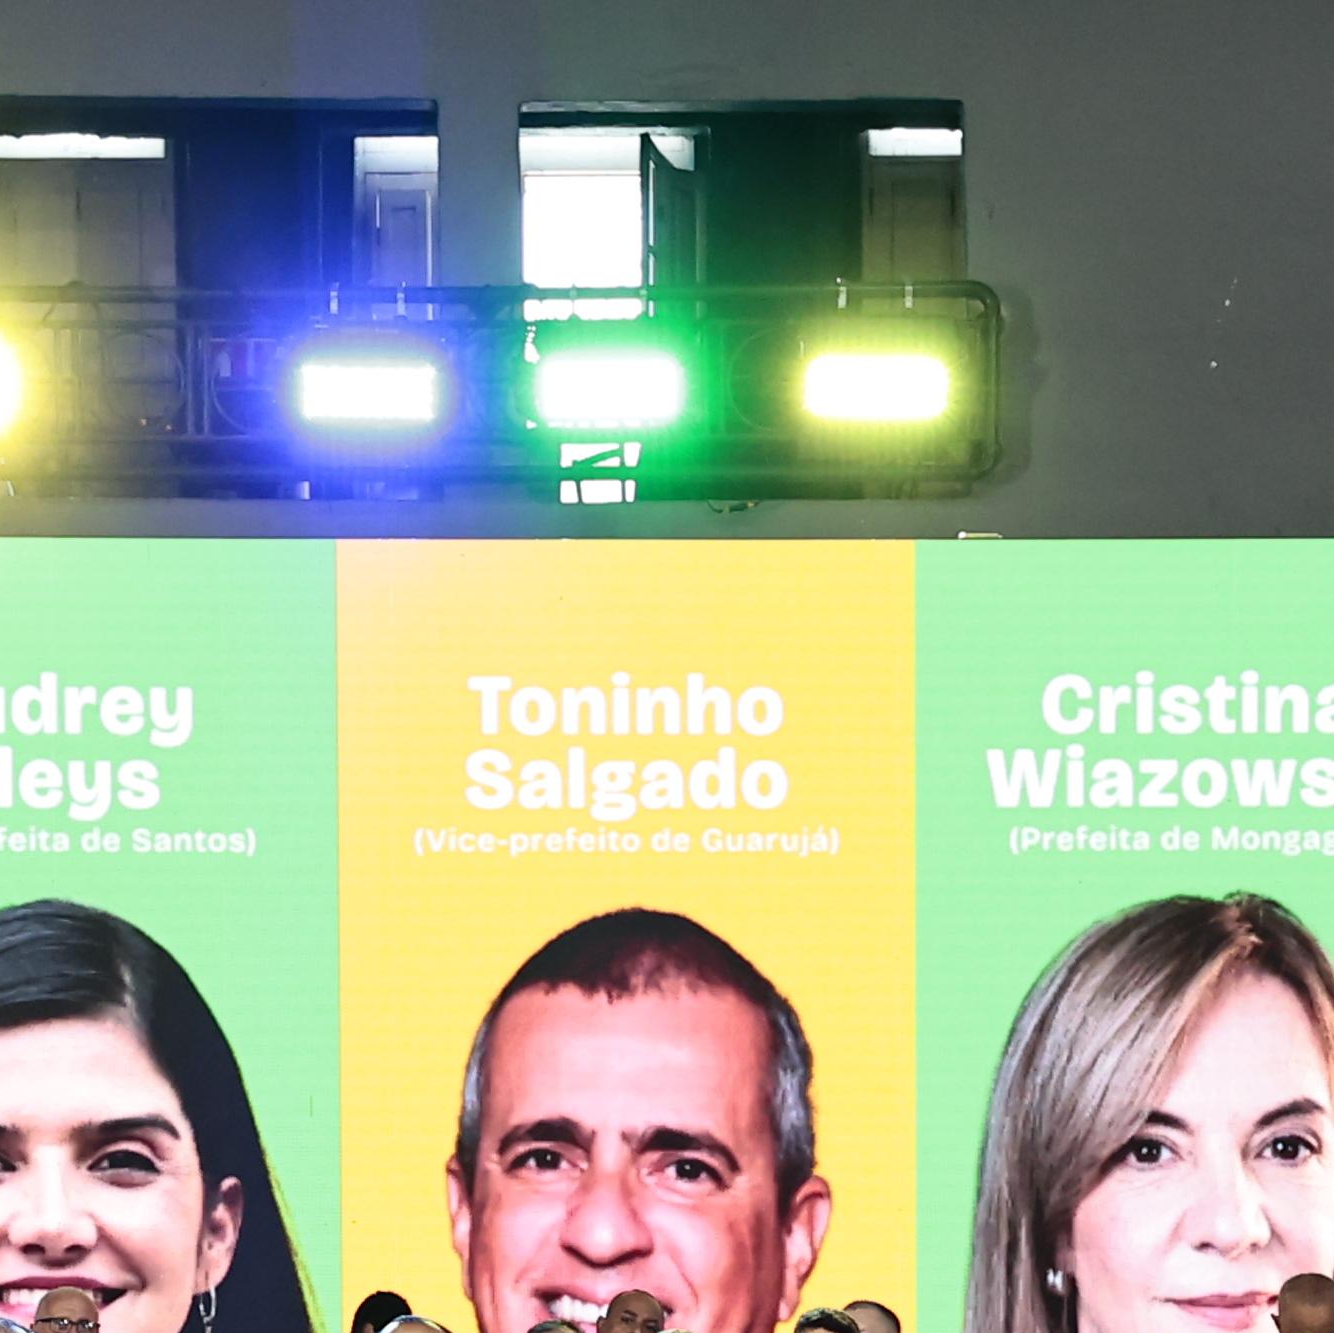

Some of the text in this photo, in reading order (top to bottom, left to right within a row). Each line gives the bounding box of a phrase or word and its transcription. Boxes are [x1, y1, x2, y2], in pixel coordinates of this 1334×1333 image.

[467, 671, 784, 737] Toninho
[465, 746, 789, 821] Salgado
[80, 827, 121, 853] de
[131, 828, 257, 857] Santos)
[413, 826, 841, 858] (Vice-prefeito de Guarujá)
[1009, 825, 1151, 856] (Prefeita
[1160, 826, 1201, 852] de
